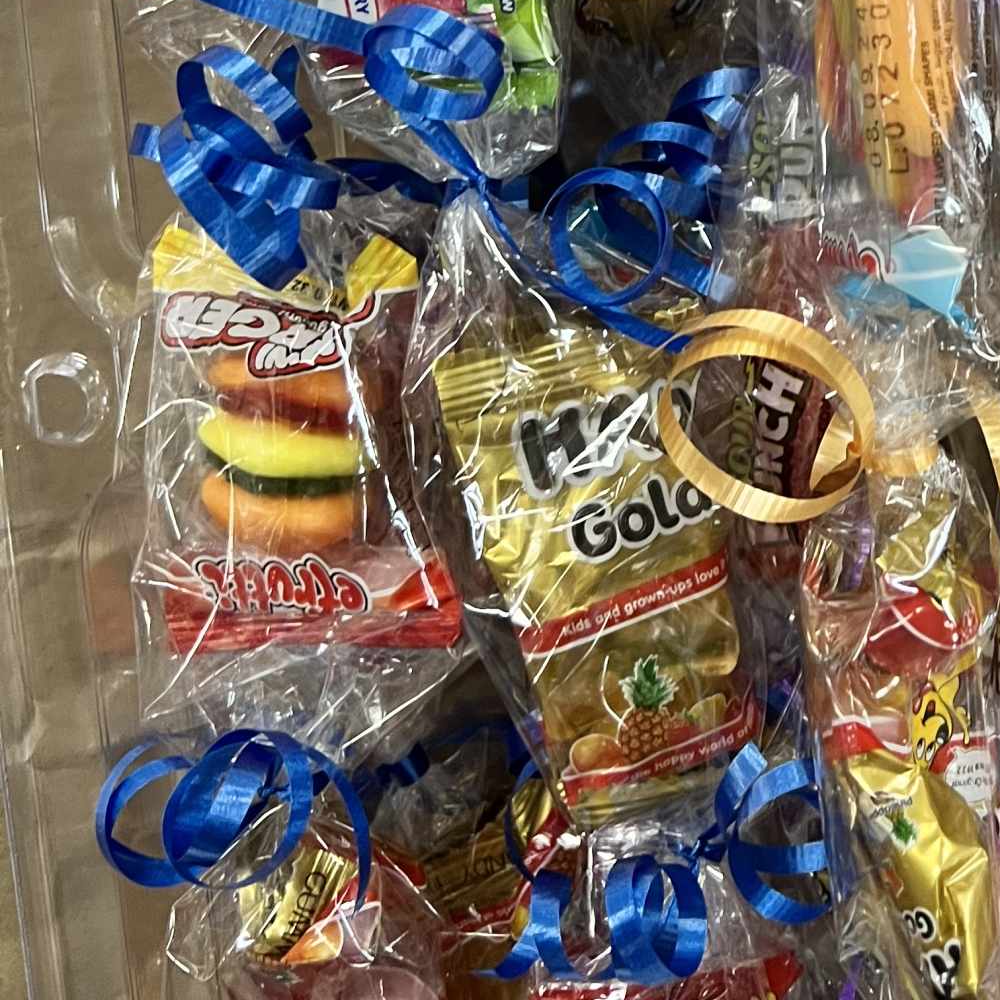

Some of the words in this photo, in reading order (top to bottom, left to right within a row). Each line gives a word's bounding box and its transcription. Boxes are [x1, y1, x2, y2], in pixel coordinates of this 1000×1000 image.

[561, 610, 592, 638] Kids
[624, 577, 686, 618] grown-ups
[687, 565, 720, 592] love
[653, 749, 695, 777] happy
